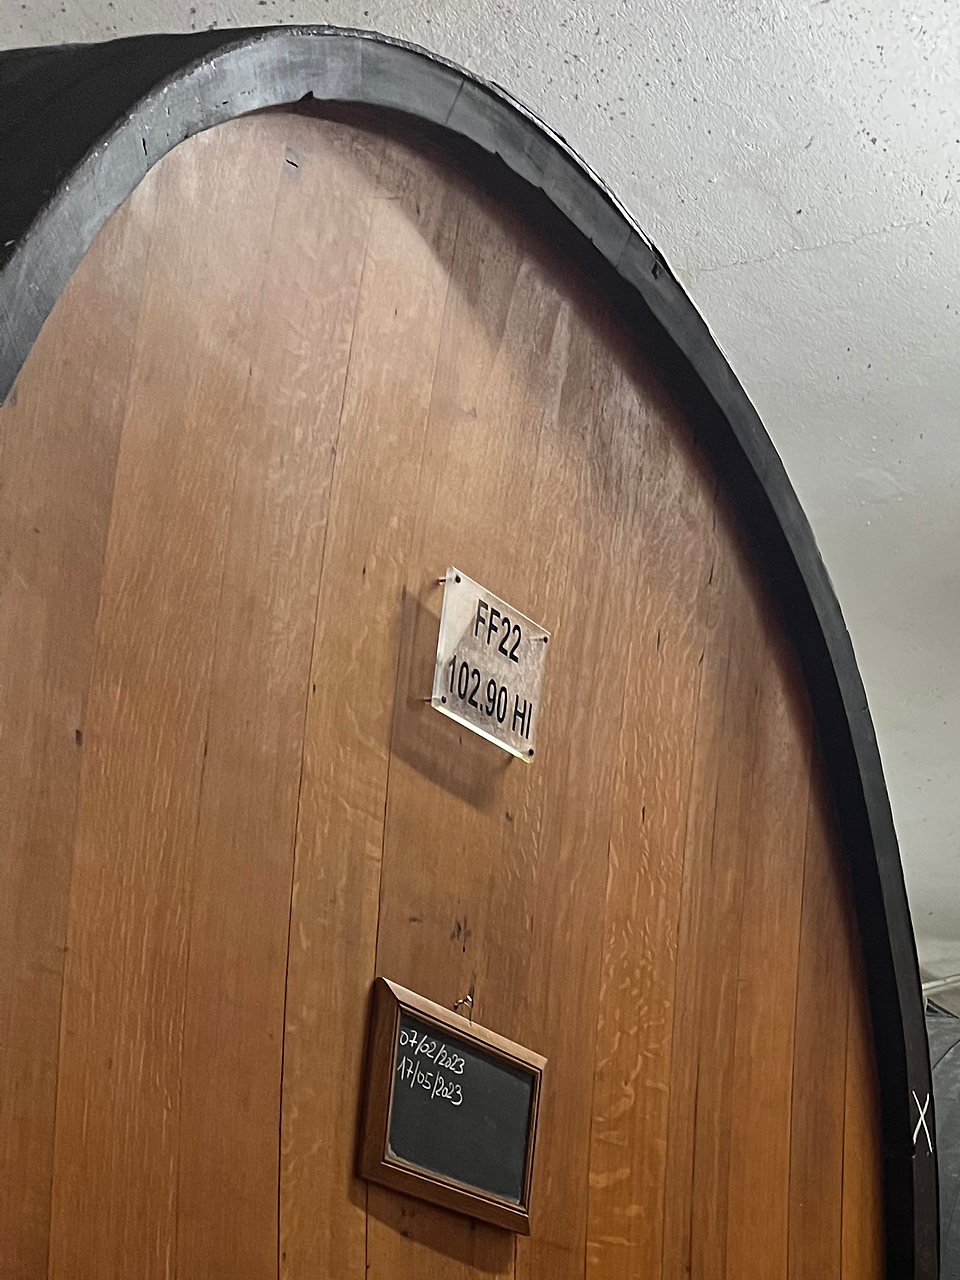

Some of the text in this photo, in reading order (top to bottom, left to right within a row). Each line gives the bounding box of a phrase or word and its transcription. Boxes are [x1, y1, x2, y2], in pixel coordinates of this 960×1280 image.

[474, 598, 522, 663] FF22
[448, 654, 508, 724] 102.90
[397, 1055, 464, 1106] 17/05/2023
[400, 1029, 466, 1075] 07/02/2023
